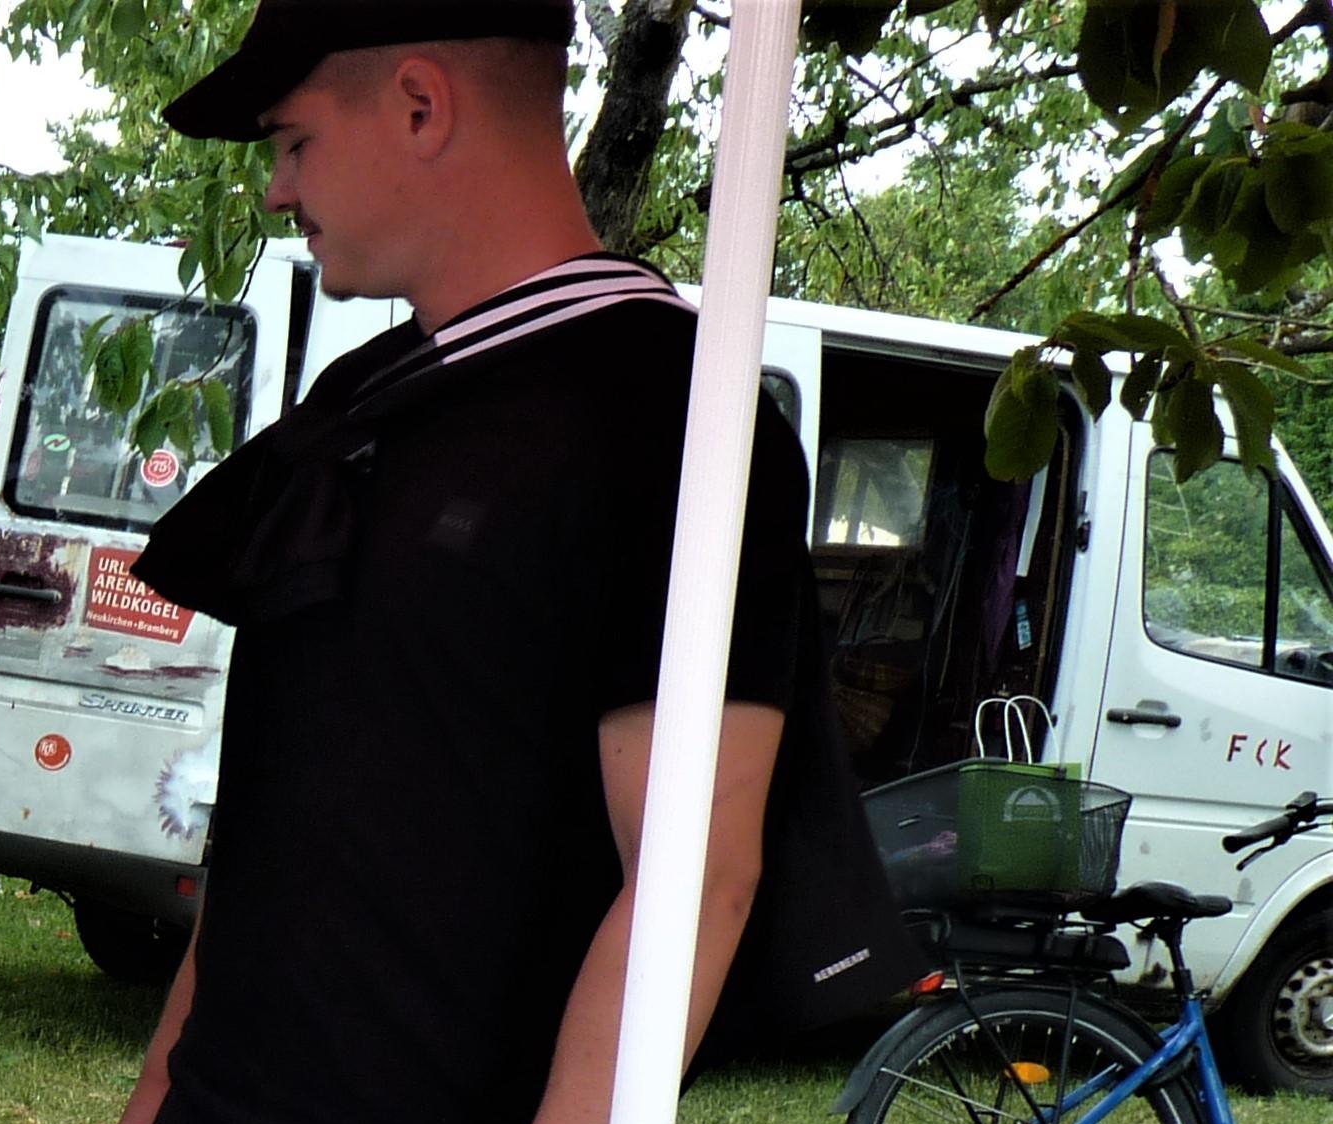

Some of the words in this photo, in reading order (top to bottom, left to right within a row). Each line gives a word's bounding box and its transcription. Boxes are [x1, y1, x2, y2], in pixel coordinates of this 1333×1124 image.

[98, 557, 130, 576] URL
[94, 573, 146, 597] ARENA
[91, 589, 181, 620] WILDKOGEL
[86, 610, 133, 628] Neukirchen
[137, 620, 180, 639] Bramberg
